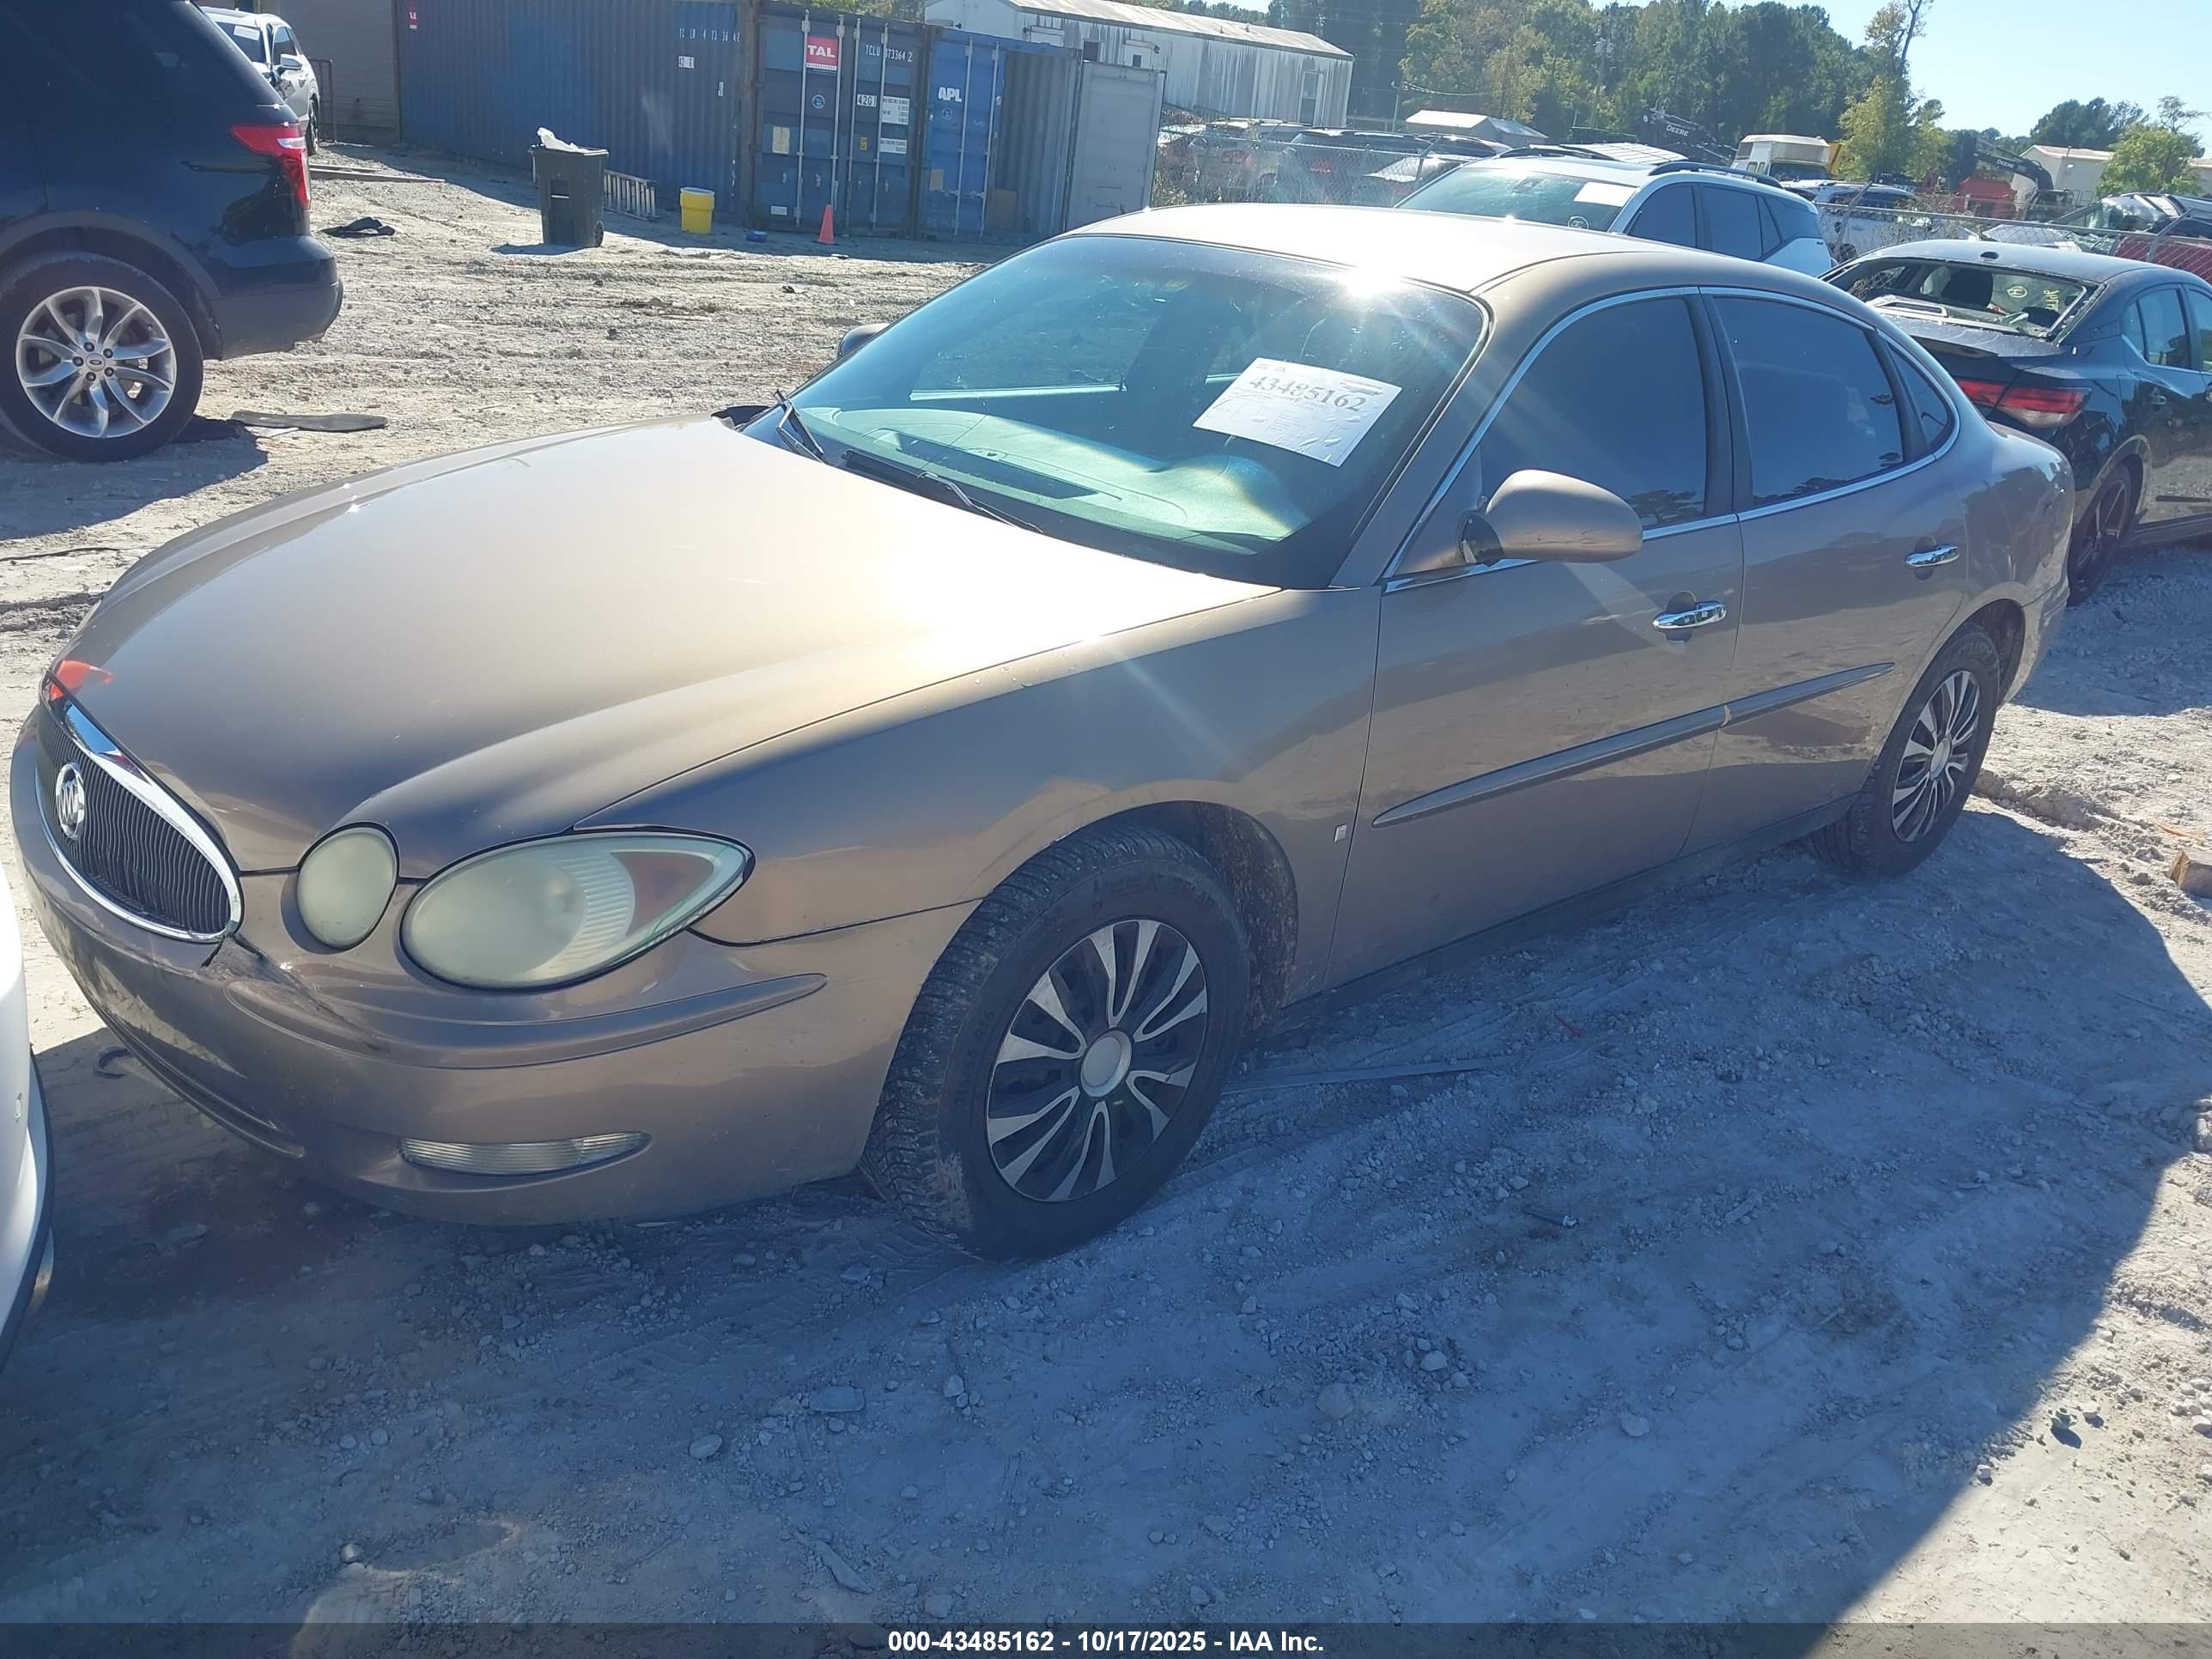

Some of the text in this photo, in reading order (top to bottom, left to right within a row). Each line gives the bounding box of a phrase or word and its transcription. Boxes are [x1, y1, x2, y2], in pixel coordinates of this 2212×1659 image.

[807, 45, 836, 58] TAL
[866, 45, 881, 57] TCLU
[938, 87, 963, 102] APL
[1666, 125, 1689, 137] DEERE
[1249, 375, 1367, 412] 43485162
